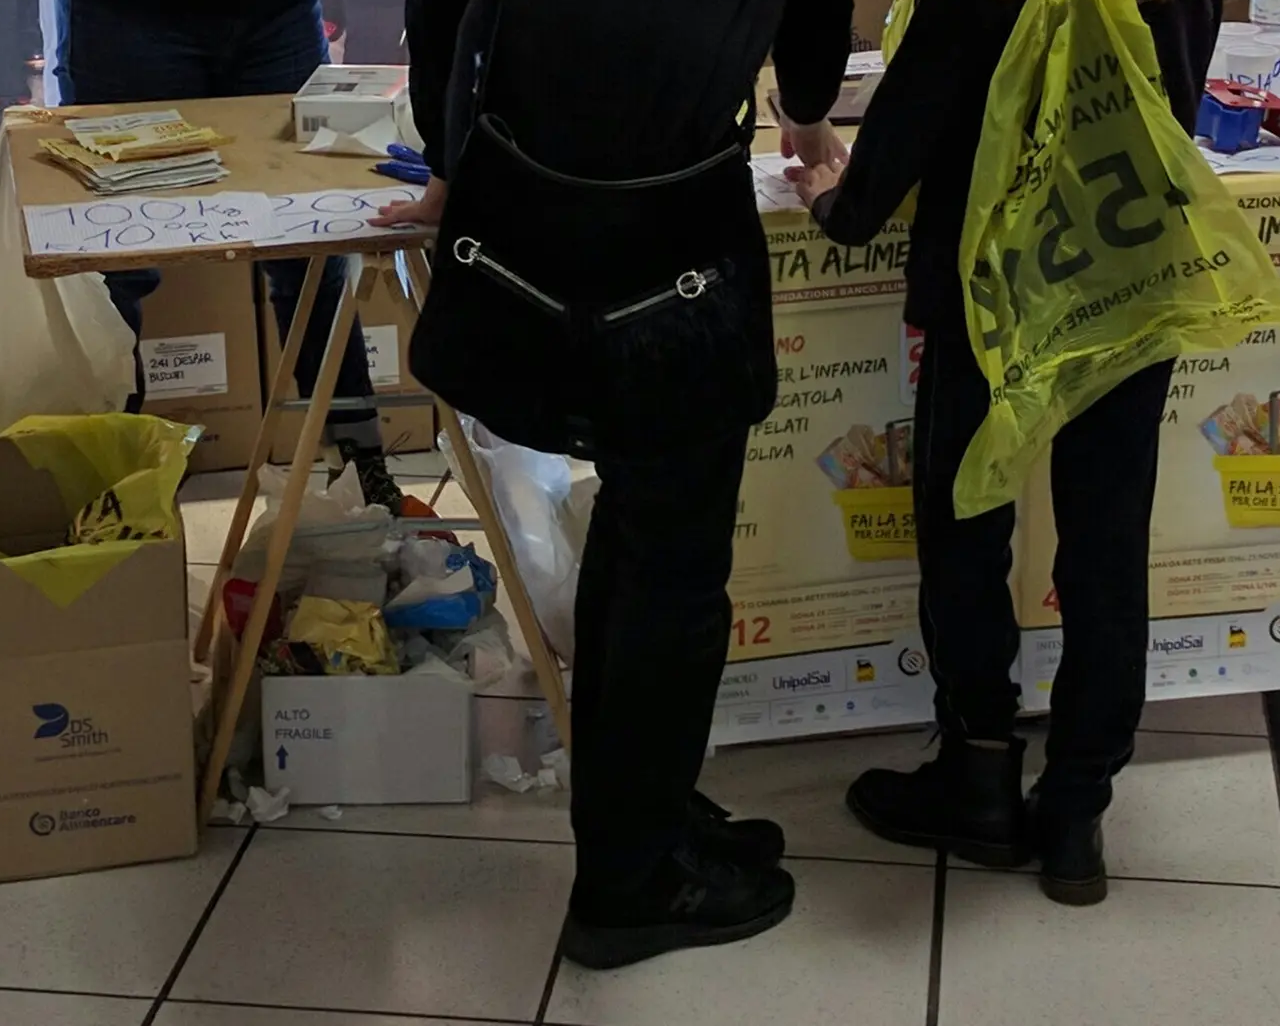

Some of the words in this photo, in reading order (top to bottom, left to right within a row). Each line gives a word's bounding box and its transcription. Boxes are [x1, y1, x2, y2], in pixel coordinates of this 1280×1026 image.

[839, 283, 878, 296] BANCO
[173, 352, 214, 367] DESPAR
[799, 357, 888, 382] L'INFANZIA
[1229, 480, 1252, 494] FAI
[1255, 480, 1274, 494] LA
[1231, 495, 1250, 507] PER
[1252, 497, 1269, 507] CHI
[850, 515, 874, 529] FAI
[876, 513, 896, 529] LA
[772, 670, 831, 692] UnipolSai
[274, 708, 311, 721] ALTO
[70, 718, 93, 735] DS
[275, 728, 334, 740] FRAGILE
[60, 729, 109, 749] Smith
